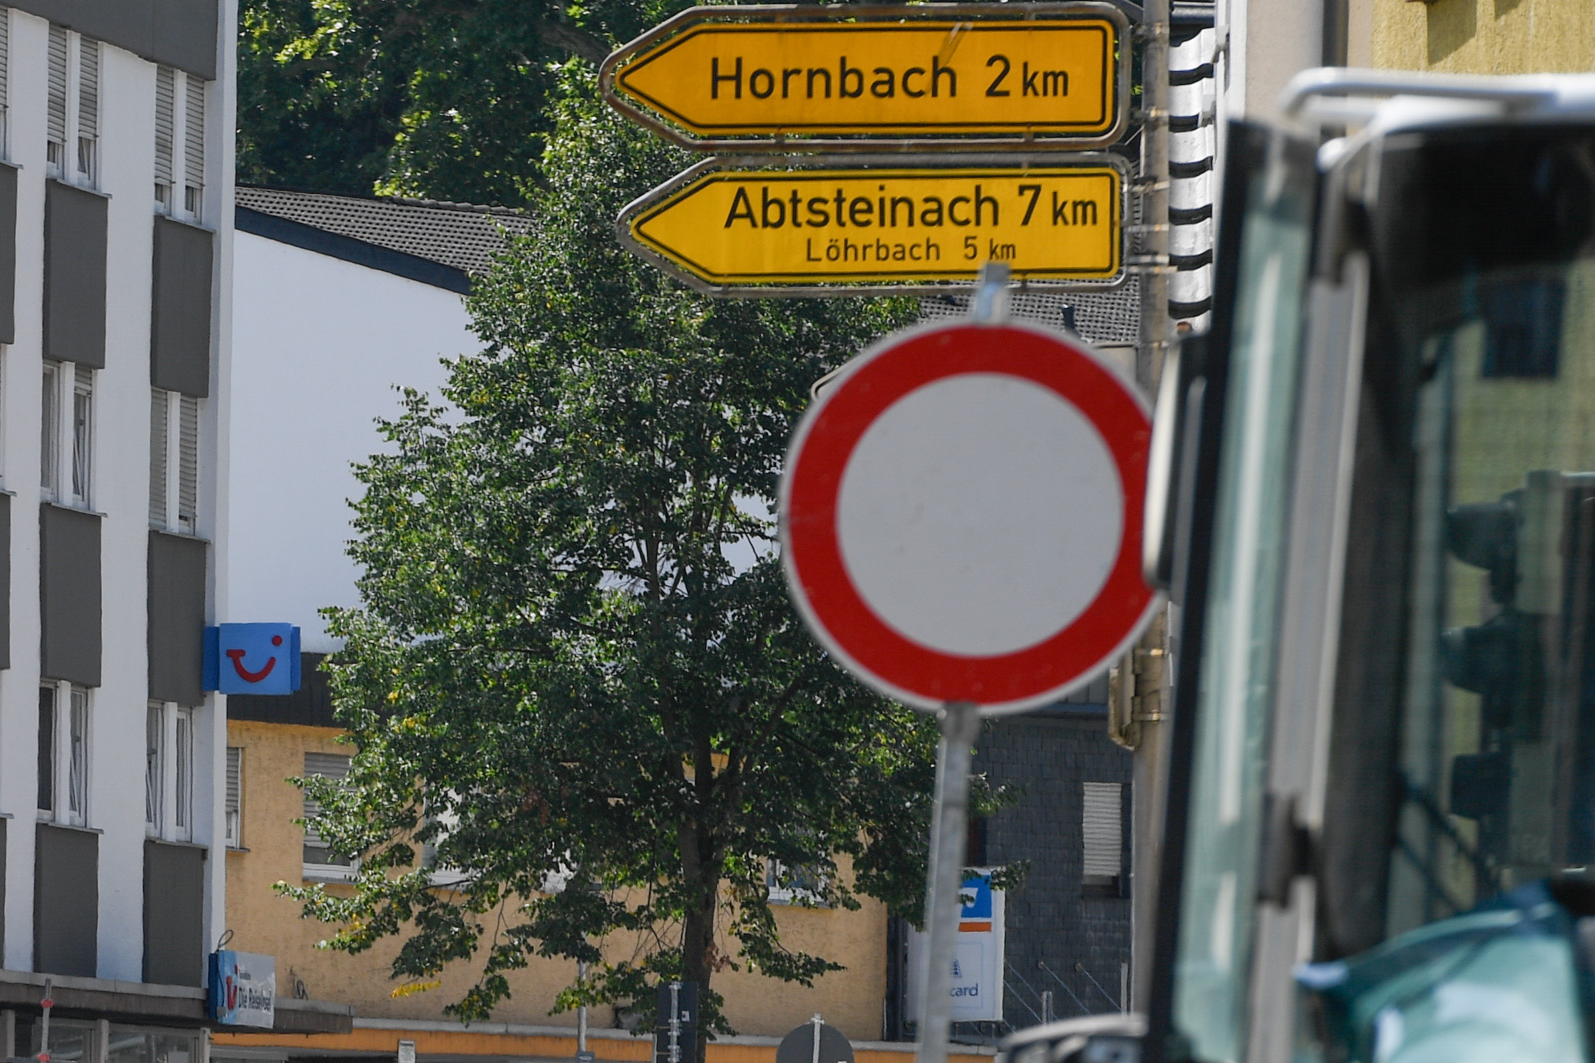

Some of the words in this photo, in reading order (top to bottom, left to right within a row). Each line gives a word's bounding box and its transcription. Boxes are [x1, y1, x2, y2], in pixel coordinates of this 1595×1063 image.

[710, 55, 957, 99] Hornbach
[985, 54, 1011, 98] 2
[1021, 62, 1069, 97] km
[724, 184, 1000, 229] Abtsteinach
[1018, 184, 1042, 227] 7
[1051, 190, 1098, 227] km
[806, 236, 941, 262] Löhrbach
[963, 235, 978, 260] 5
[988, 237, 1017, 262] km
[949, 983, 979, 997] card
